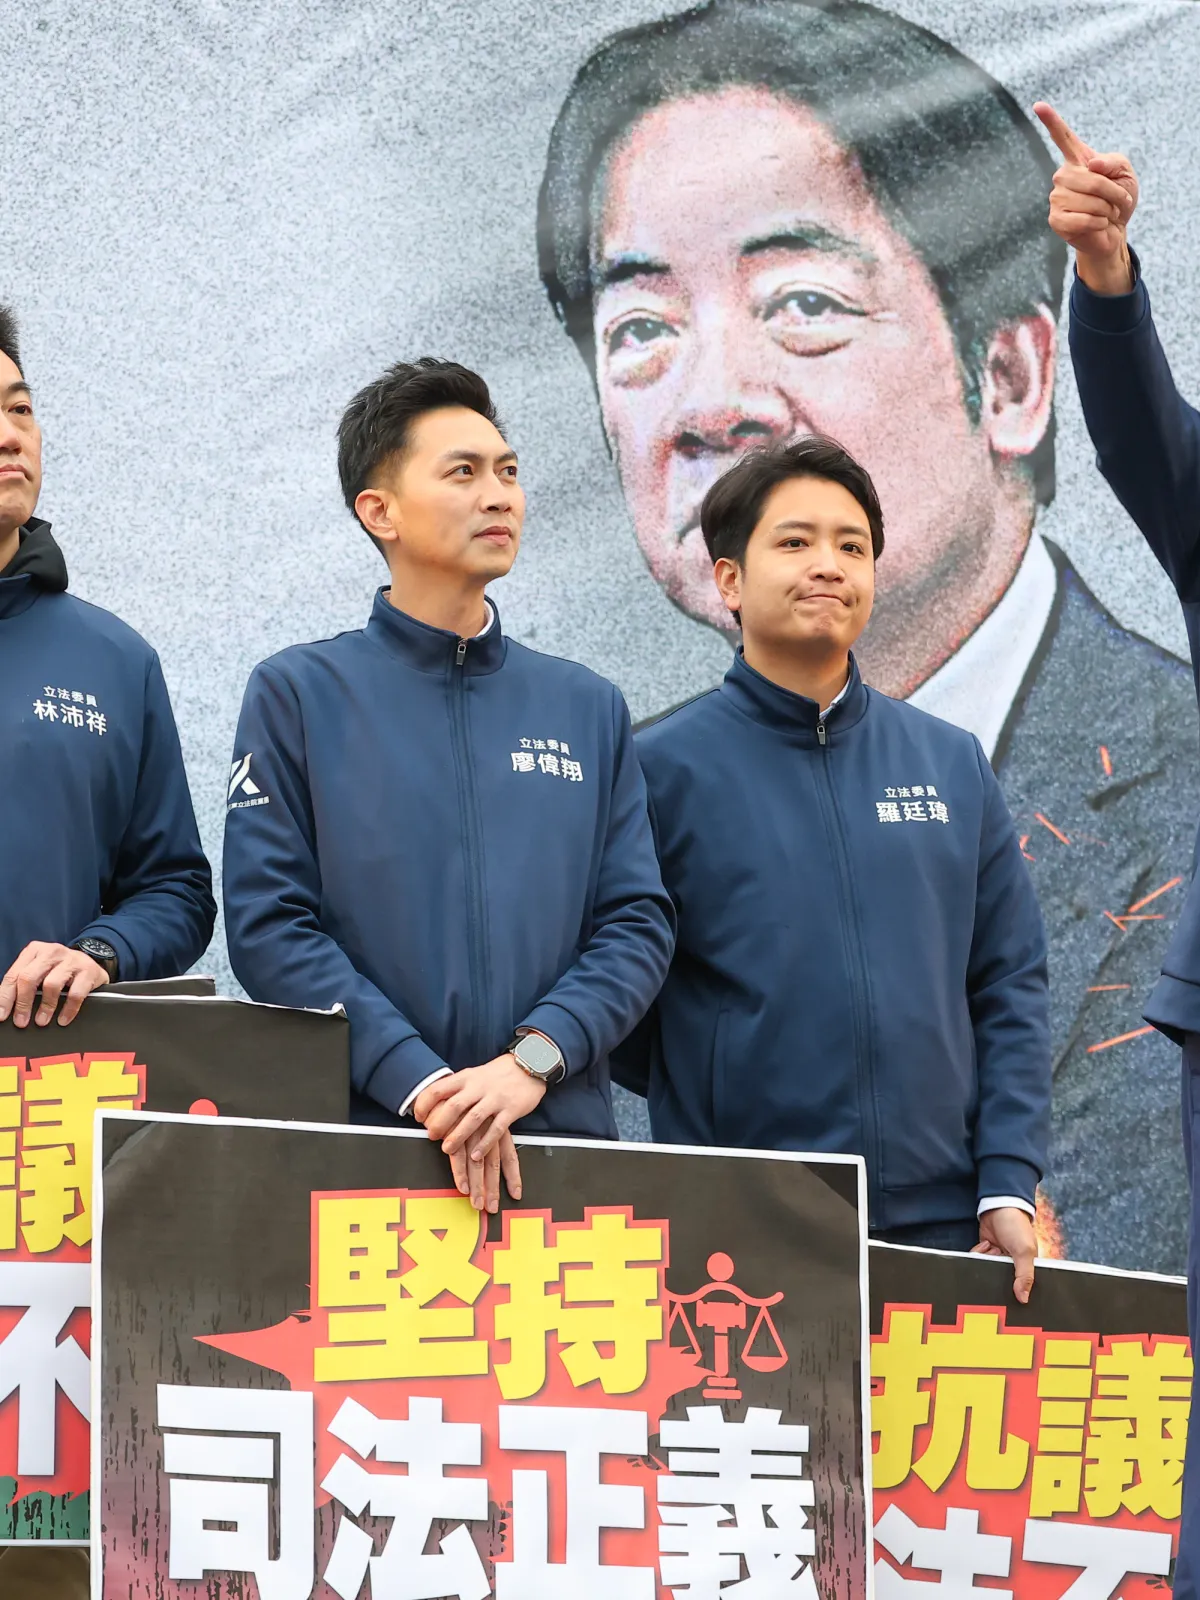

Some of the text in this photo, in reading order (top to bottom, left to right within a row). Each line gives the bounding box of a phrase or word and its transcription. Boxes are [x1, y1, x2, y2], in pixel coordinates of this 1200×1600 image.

[43, 685, 98, 708] 立法委員
[32, 698, 107, 736] 林沛祥
[518, 737, 571, 756] 立法委員
[510, 751, 584, 782] 廖偉翔
[884, 785, 939, 799] 立法委員
[875, 800, 950, 824] 羅廷瑋
[313, 1195, 664, 1400] 堅持
[870, 1309, 1195, 1521] 抗議
[155, 1383, 817, 1600] 司法正義
